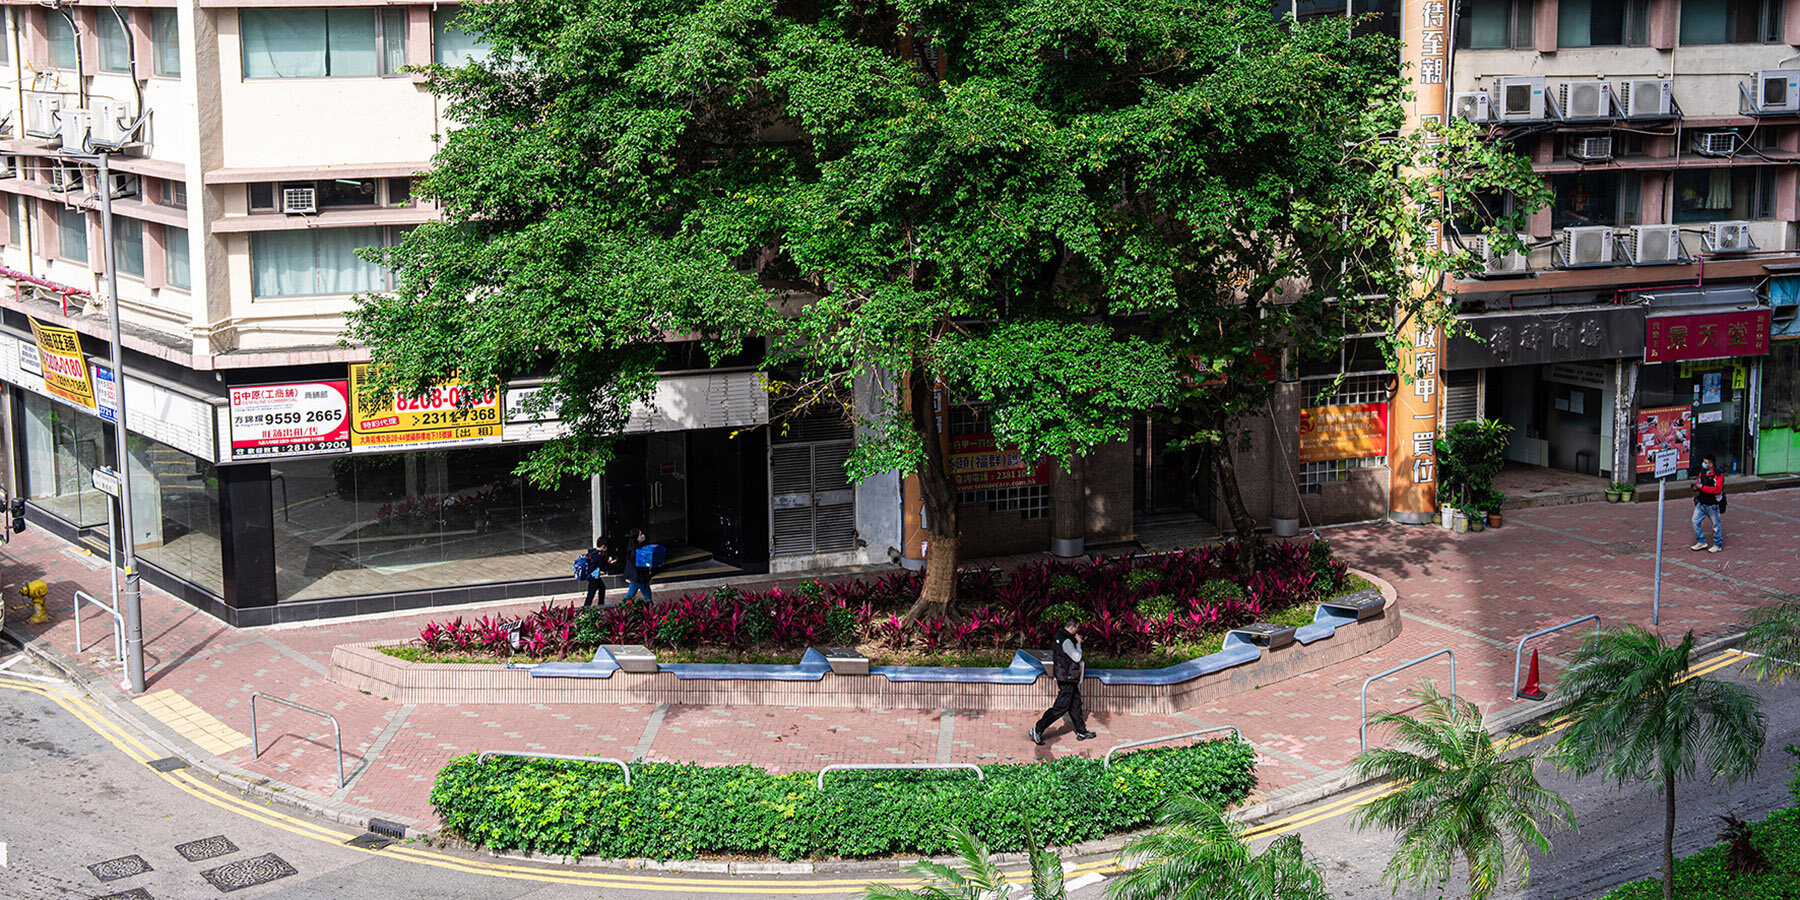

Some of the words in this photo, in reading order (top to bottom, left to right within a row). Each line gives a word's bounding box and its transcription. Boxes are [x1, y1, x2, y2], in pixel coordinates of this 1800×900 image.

[1421, 1, 1444, 84] 待至親
[1668, 321, 1748, 350] 景天堂
[1412, 323, 1436, 483] 政府甲一買位
[265, 412, 301, 425] 9559
[306, 409, 342, 422] 2665
[287, 443, 315, 452] 2810
[319, 441, 347, 449] 9900
[997, 471, 1015, 480] 2381
